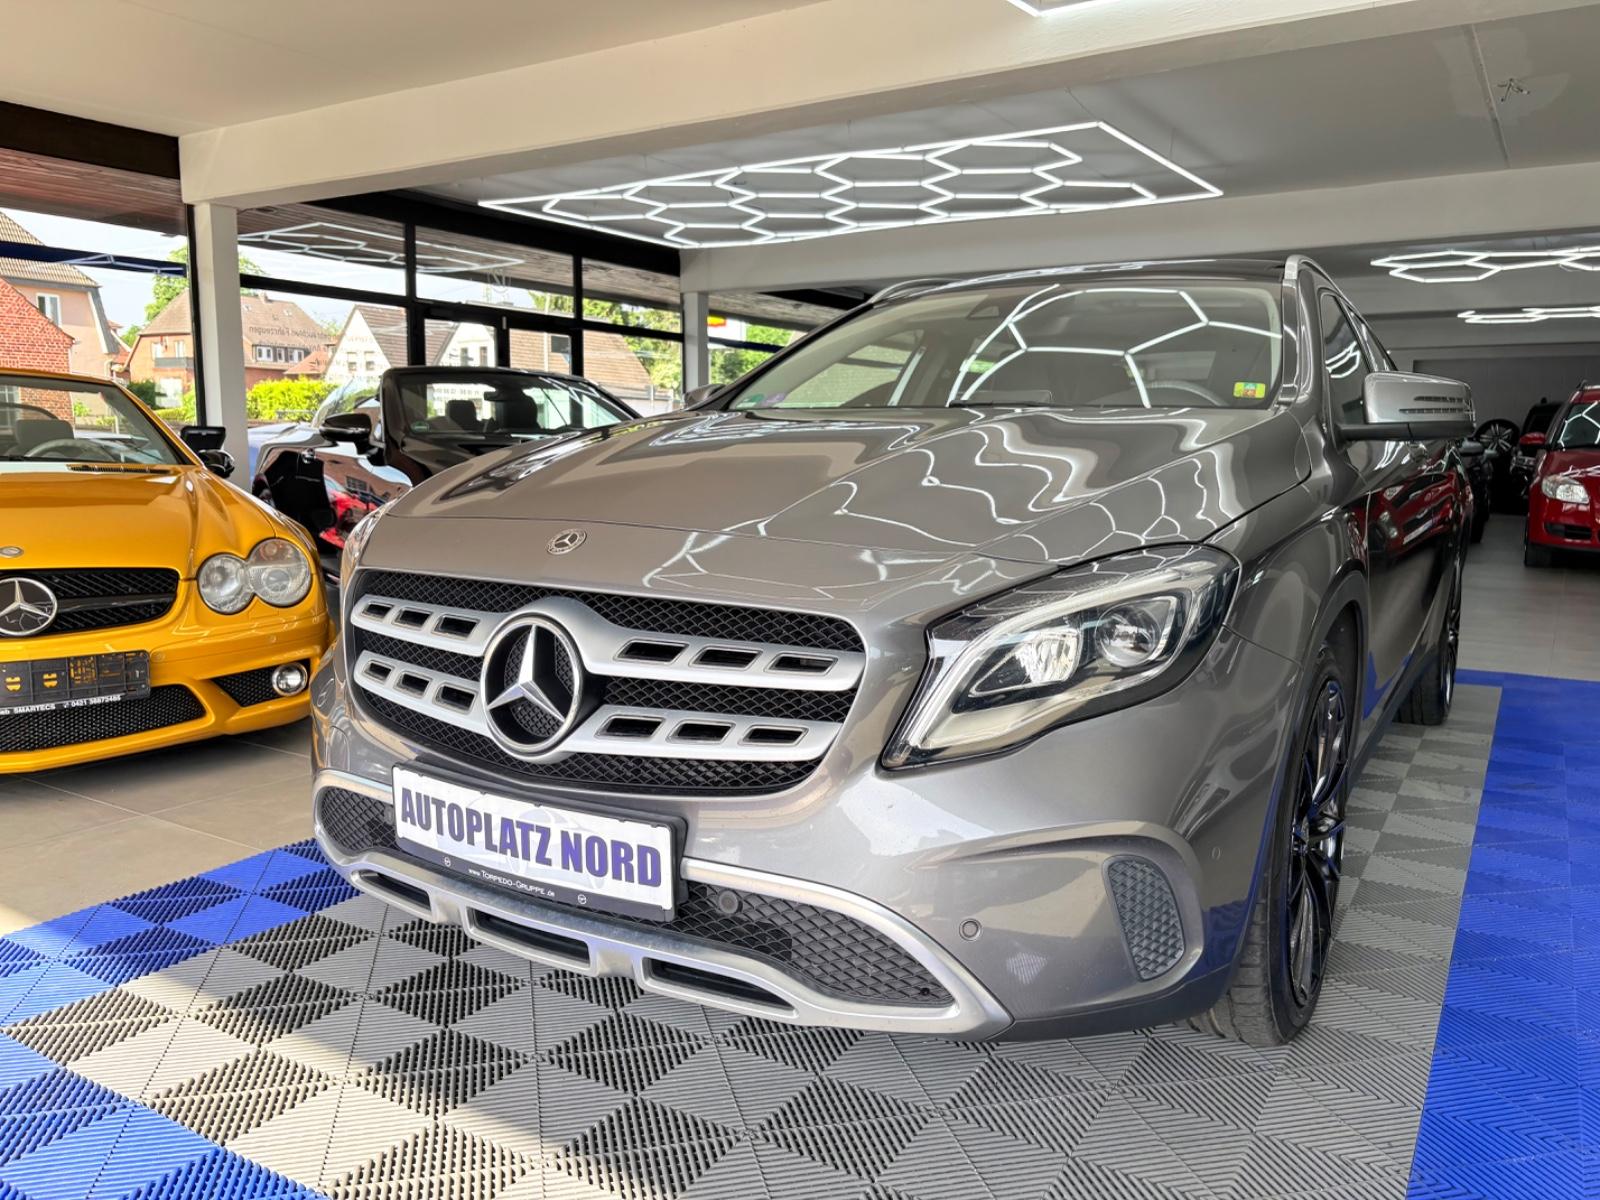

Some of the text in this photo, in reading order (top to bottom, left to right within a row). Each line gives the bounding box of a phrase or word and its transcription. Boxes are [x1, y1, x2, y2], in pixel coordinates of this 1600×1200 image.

[14, 703, 56, 715] SMARTECS
[401, 787, 662, 888] AUTOPLATZ NORD
